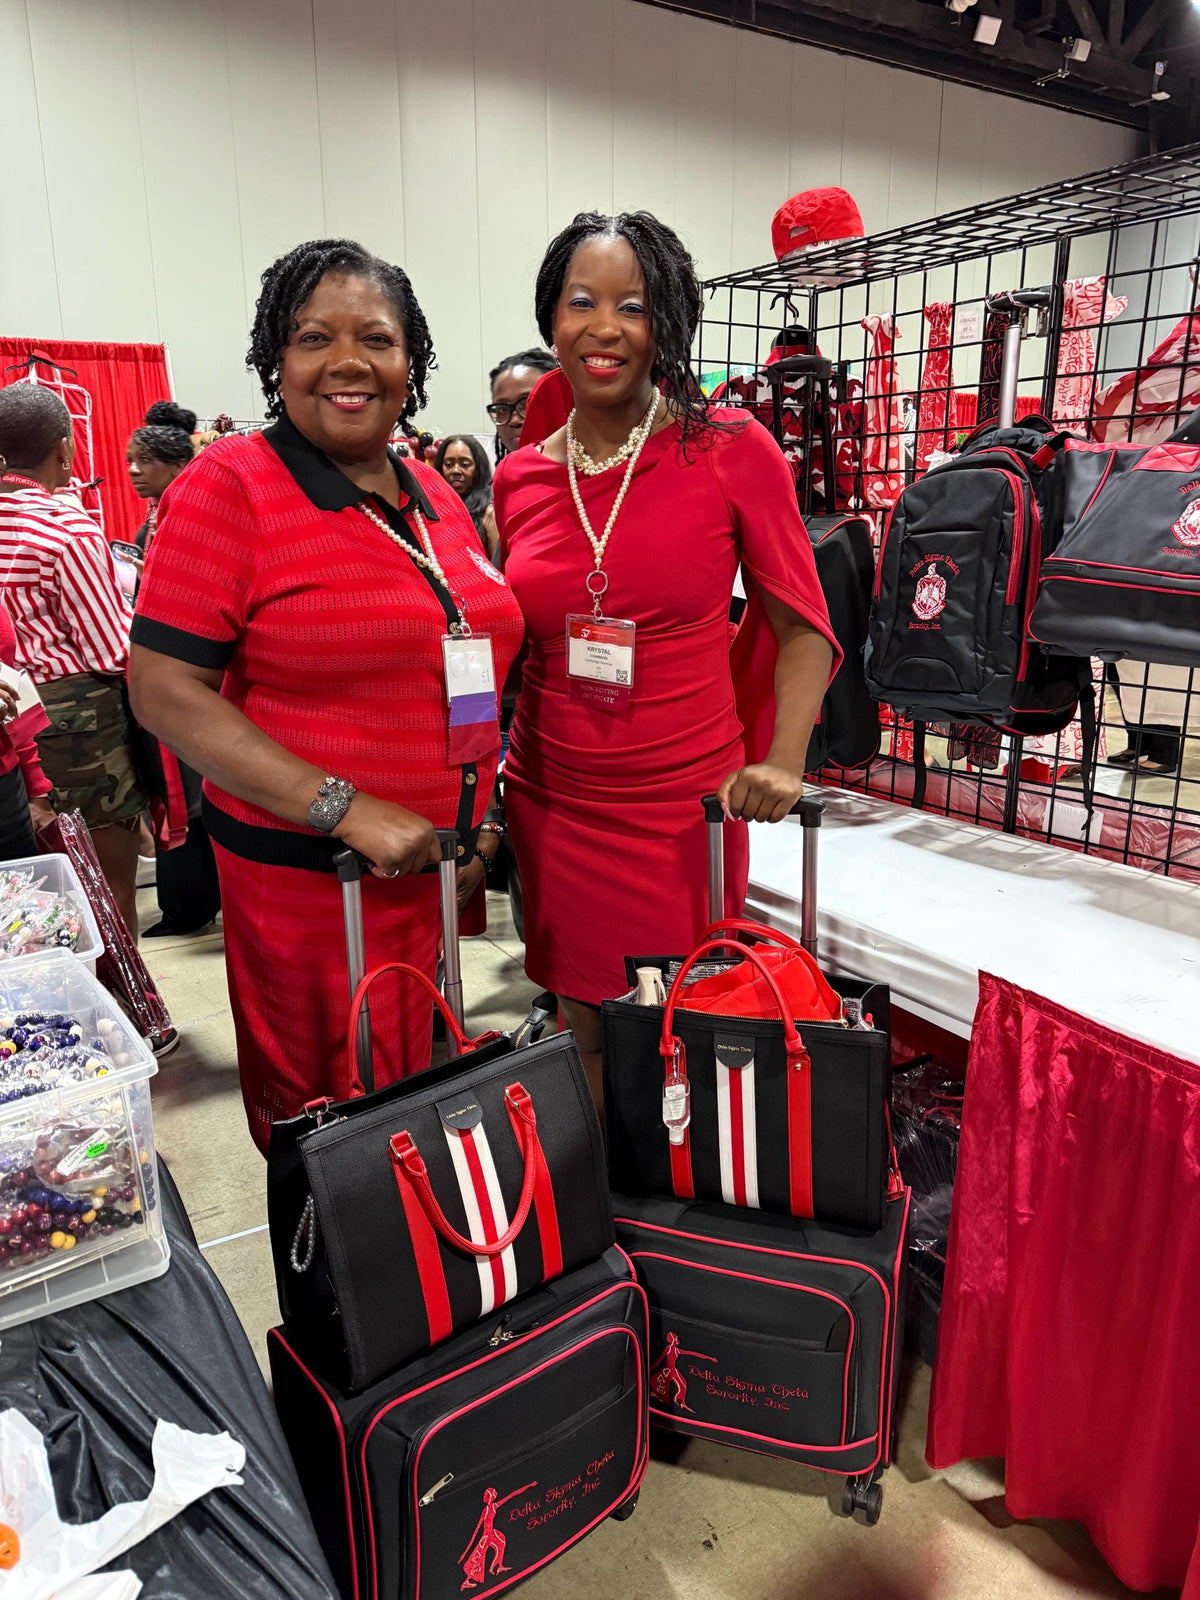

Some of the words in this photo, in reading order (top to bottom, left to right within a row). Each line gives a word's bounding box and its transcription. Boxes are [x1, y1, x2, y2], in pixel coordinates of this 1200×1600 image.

[1179, 480, 1200, 495] Delt
[587, 646, 612, 655] KRYSTAL
[580, 684, 619, 696] NON-VOTING
[689, 1365, 720, 1383] Delta
[725, 1376, 767, 1394] Sigma
[771, 1384, 809, 1399] Theta
[508, 1501, 541, 1523] Delta
[545, 1475, 582, 1504] Sigma
[586, 1449, 615, 1477] Theta
